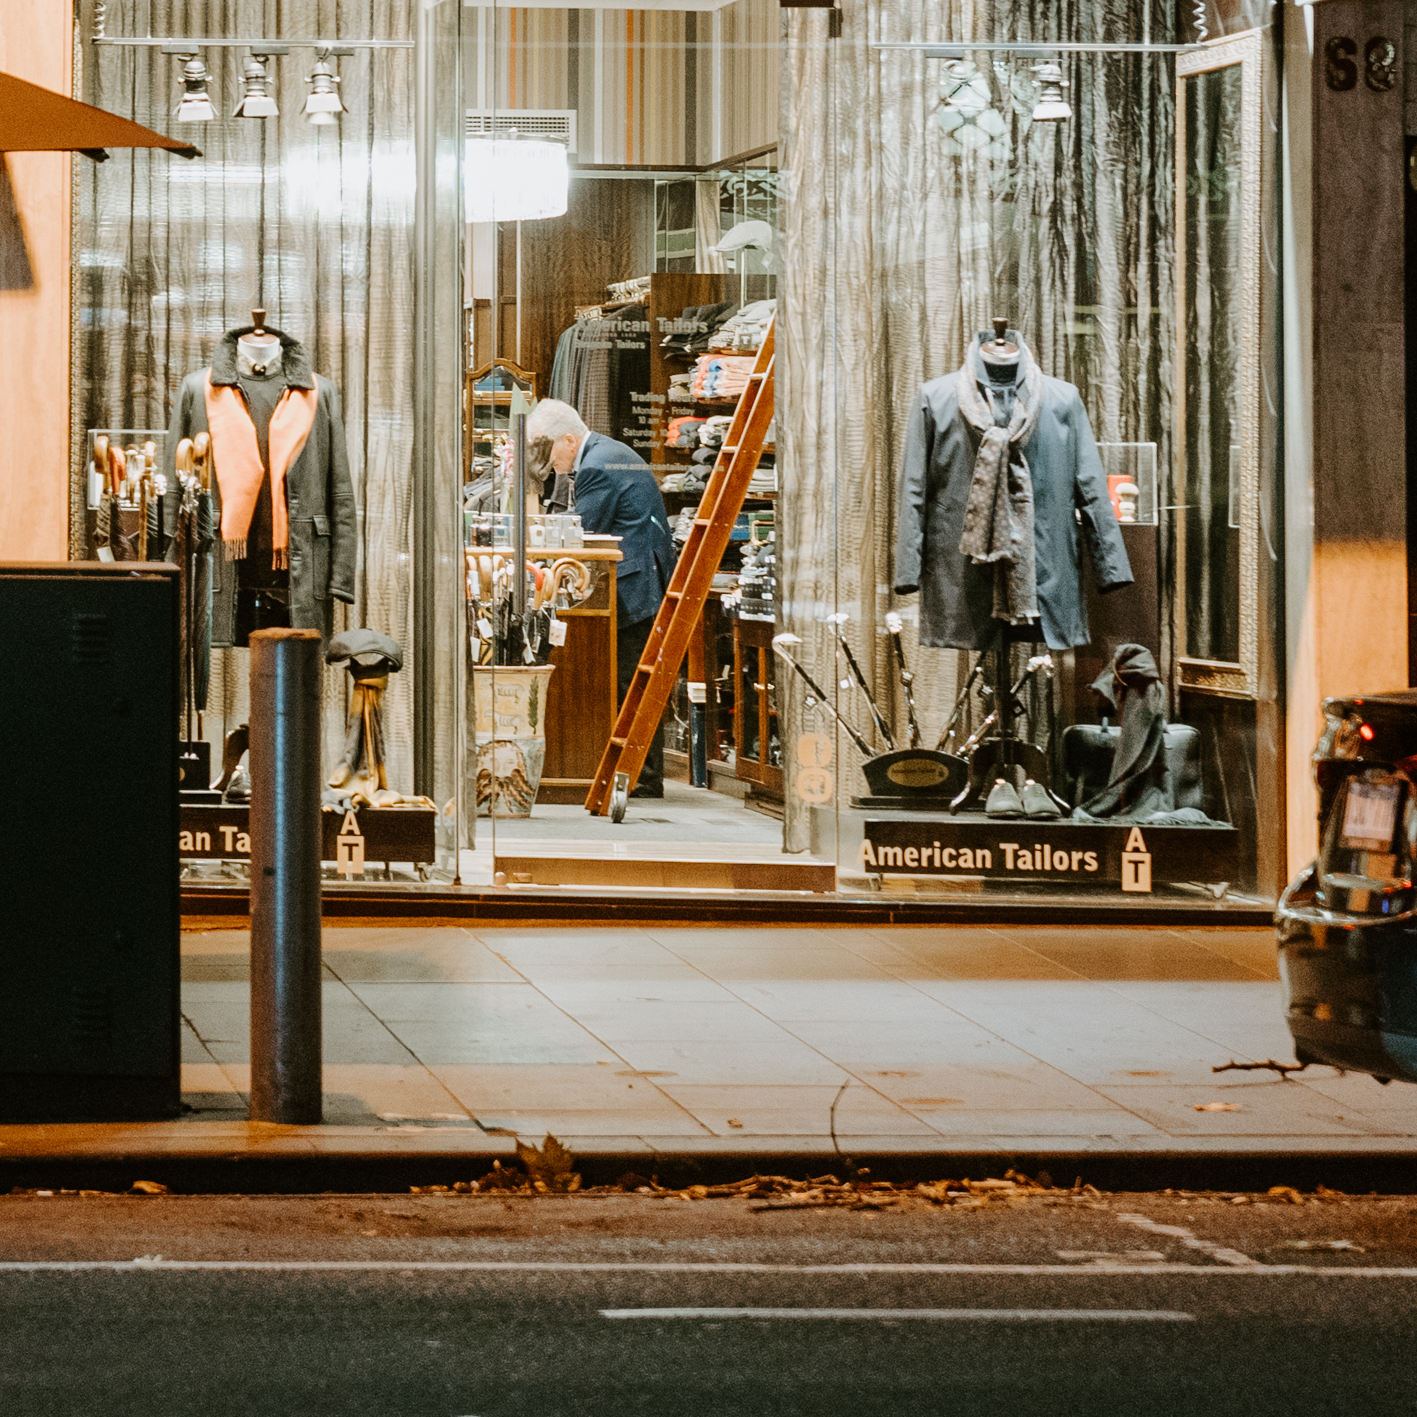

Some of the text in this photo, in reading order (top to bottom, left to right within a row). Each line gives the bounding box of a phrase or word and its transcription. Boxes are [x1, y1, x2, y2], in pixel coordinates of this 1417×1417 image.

[656, 316, 708, 333] Tailors
[629, 391, 665, 404] Trading
[340, 811, 361, 835] A
[1125, 826, 1147, 852] A
[856, 838, 1099, 872] American Tailors
